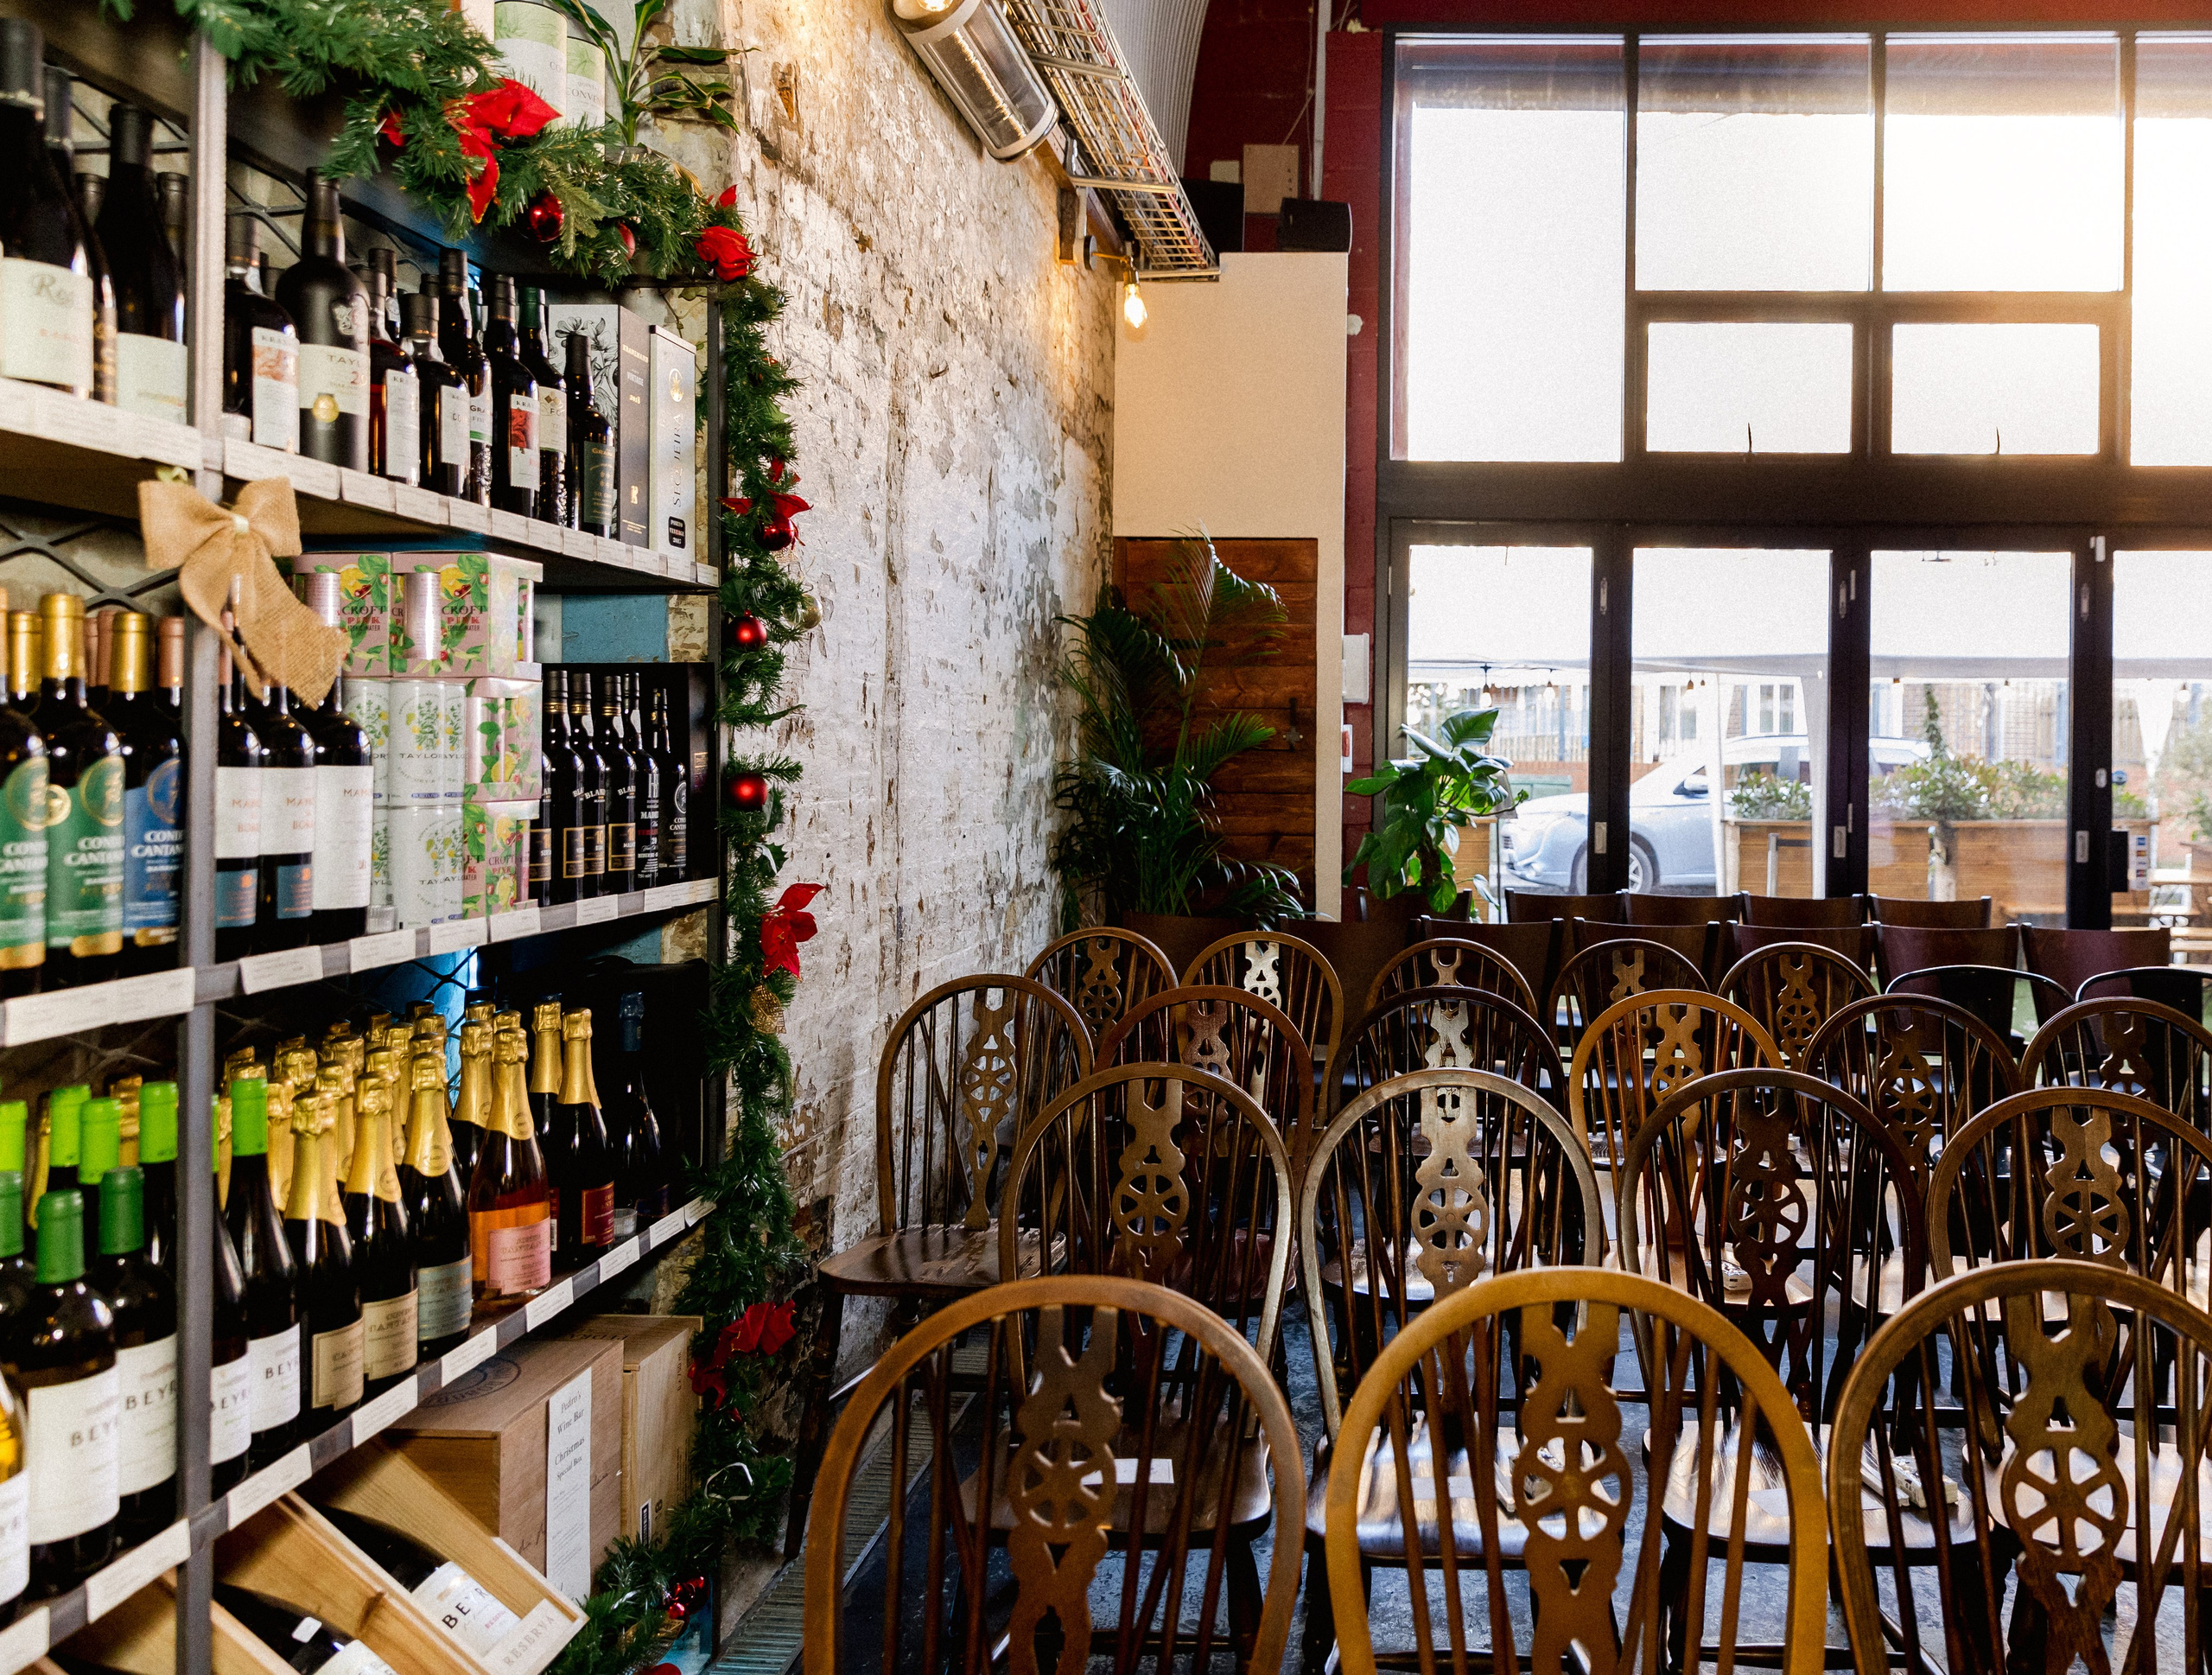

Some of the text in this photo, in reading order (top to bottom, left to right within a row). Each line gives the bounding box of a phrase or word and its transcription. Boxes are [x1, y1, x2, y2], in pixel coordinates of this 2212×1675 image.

[341, 605, 385, 615] CROFT
[442, 605, 485, 615] CROFT
[561, 1390, 582, 1414] Pedro's
[556, 1408, 585, 1435] Wine Bar
[555, 1436, 585, 1466] Christmas
[556, 1455, 582, 1481] Special Box
[502, 1614, 556, 1666] RESERVA
